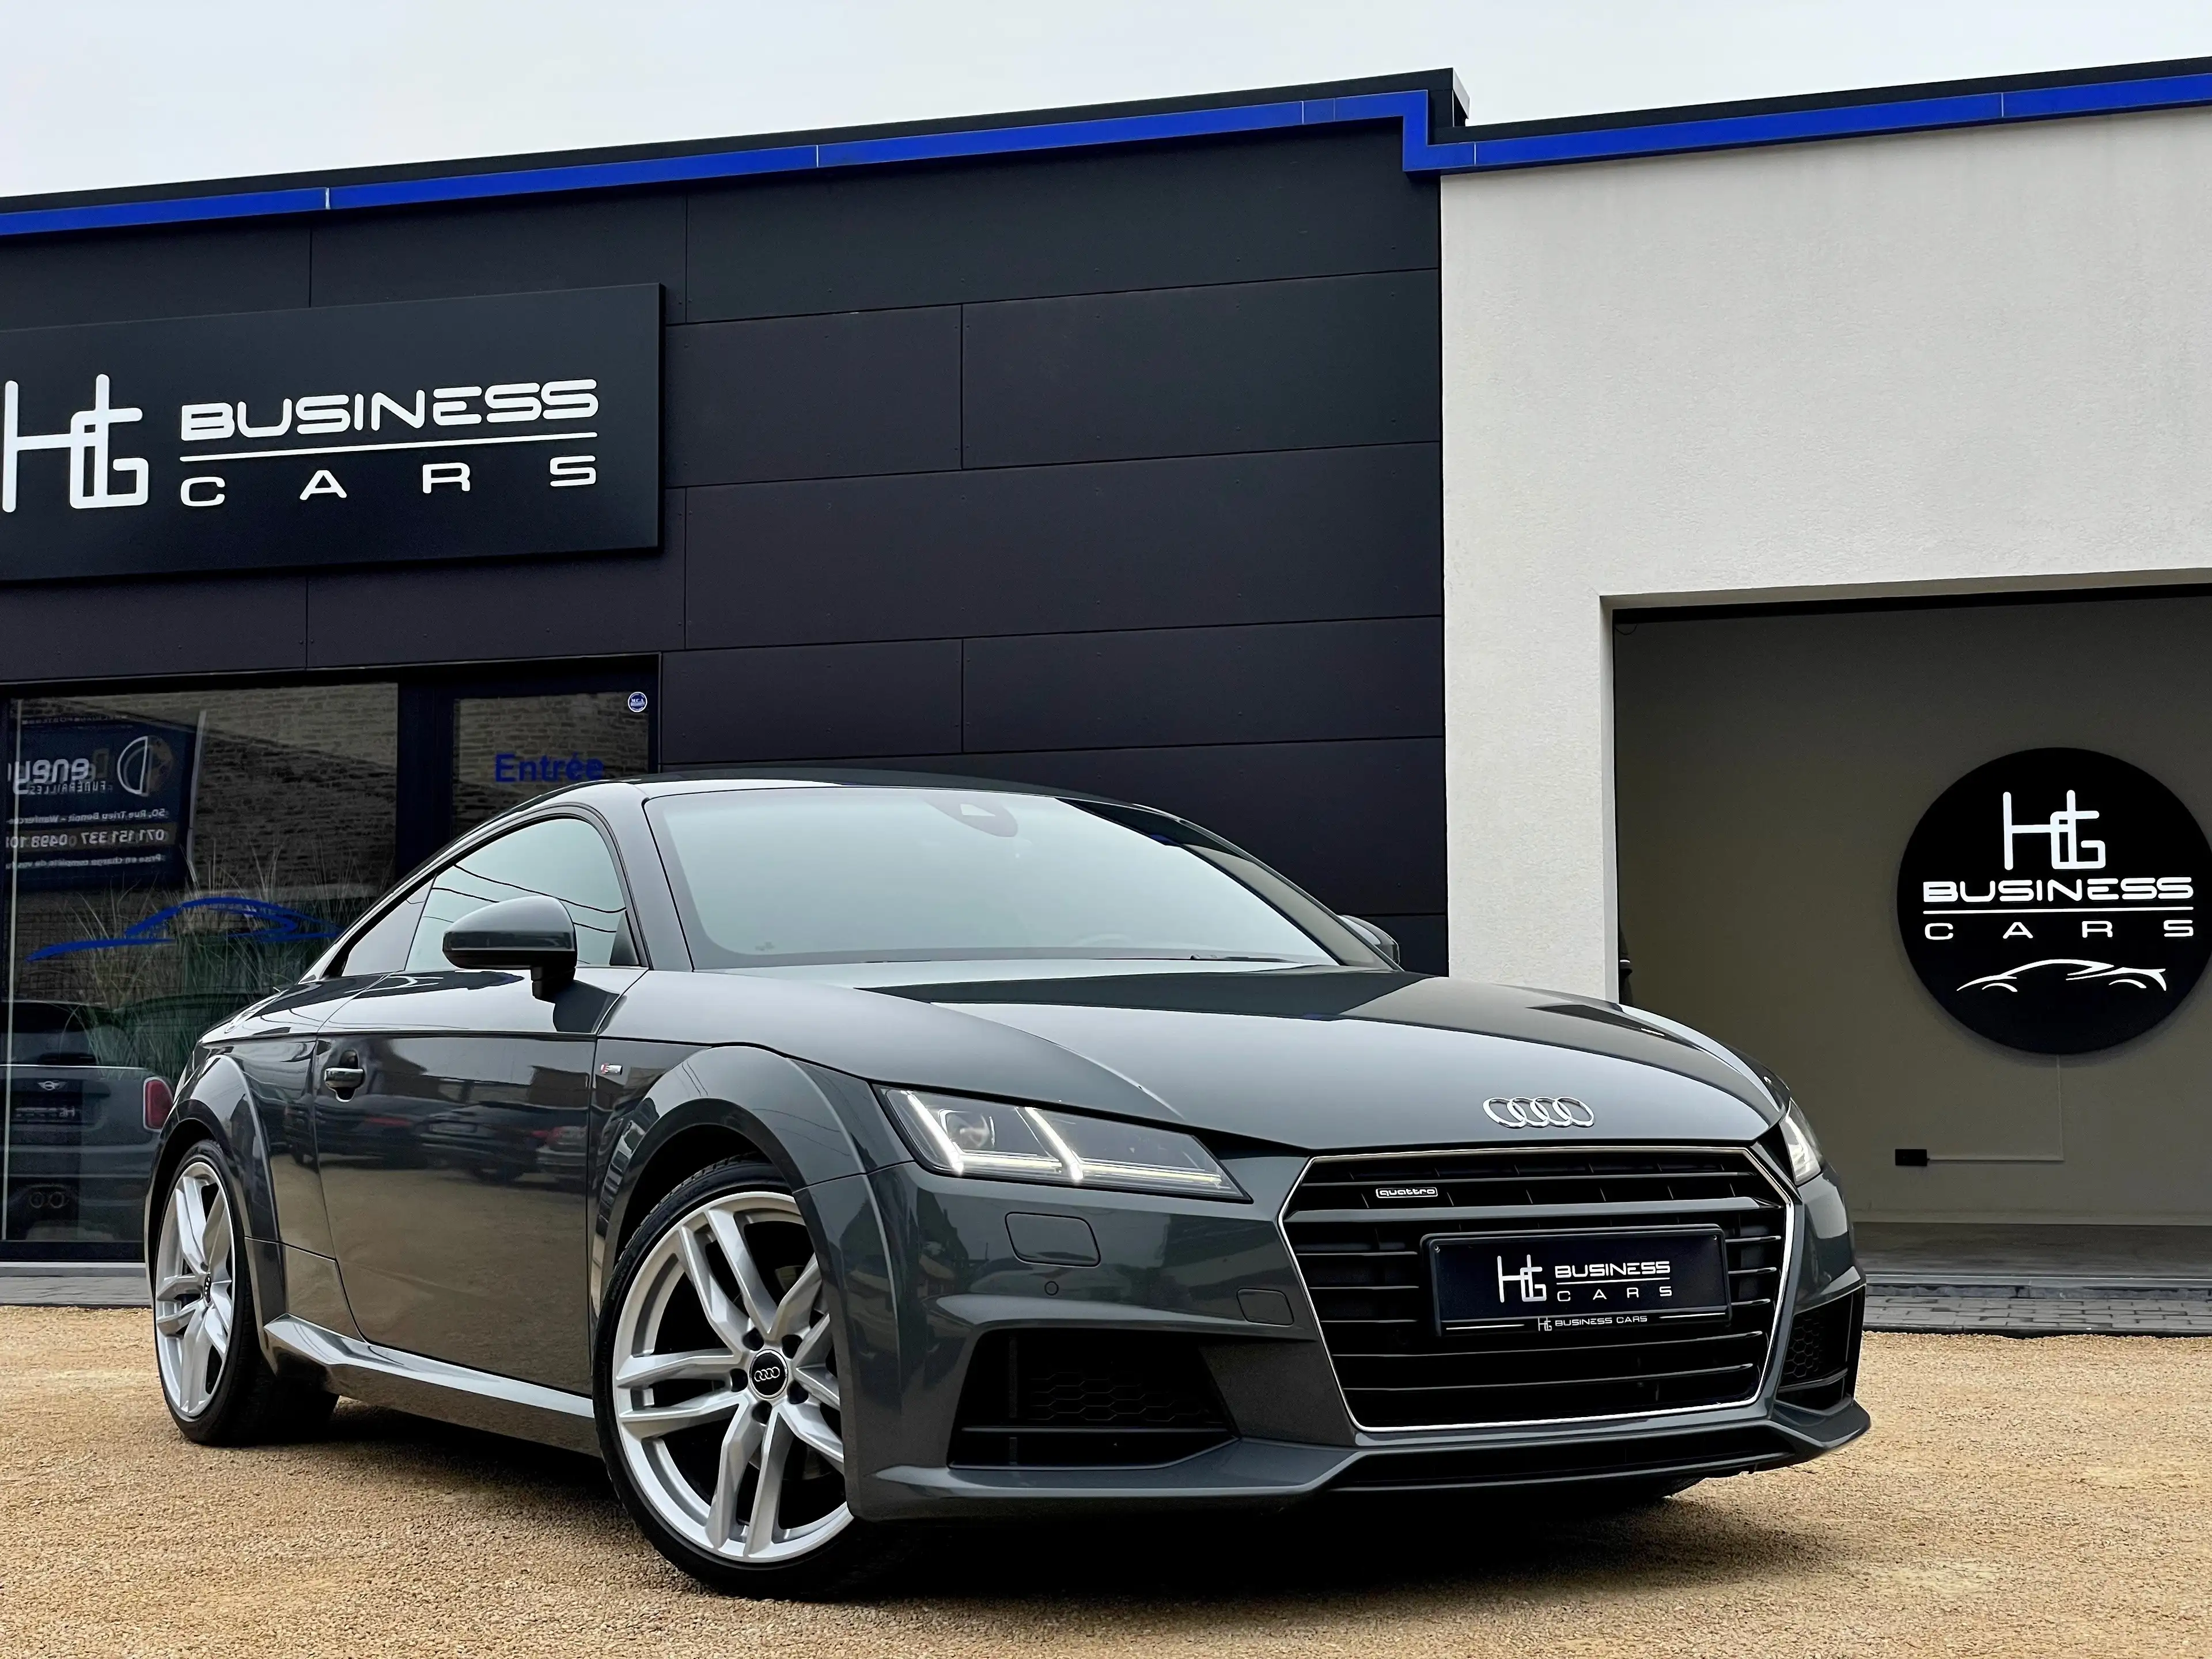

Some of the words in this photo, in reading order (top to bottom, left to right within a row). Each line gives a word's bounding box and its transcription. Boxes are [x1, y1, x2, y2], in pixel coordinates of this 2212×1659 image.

[181, 379, 599, 441] BUSINESS
[180, 455, 597, 507] CARS
[495, 751, 604, 782] Entrée
[1923, 877, 2195, 903] BUSINESS
[1925, 919, 2194, 940] CARS
[1379, 1188, 1435, 1197] quattro
[1555, 1261, 1671, 1278] BUSINESS
[1557, 1286, 1672, 1302] CARS
[1555, 1317, 1612, 1327] BUSINESS
[1616, 1316, 1647, 1324] CARS
